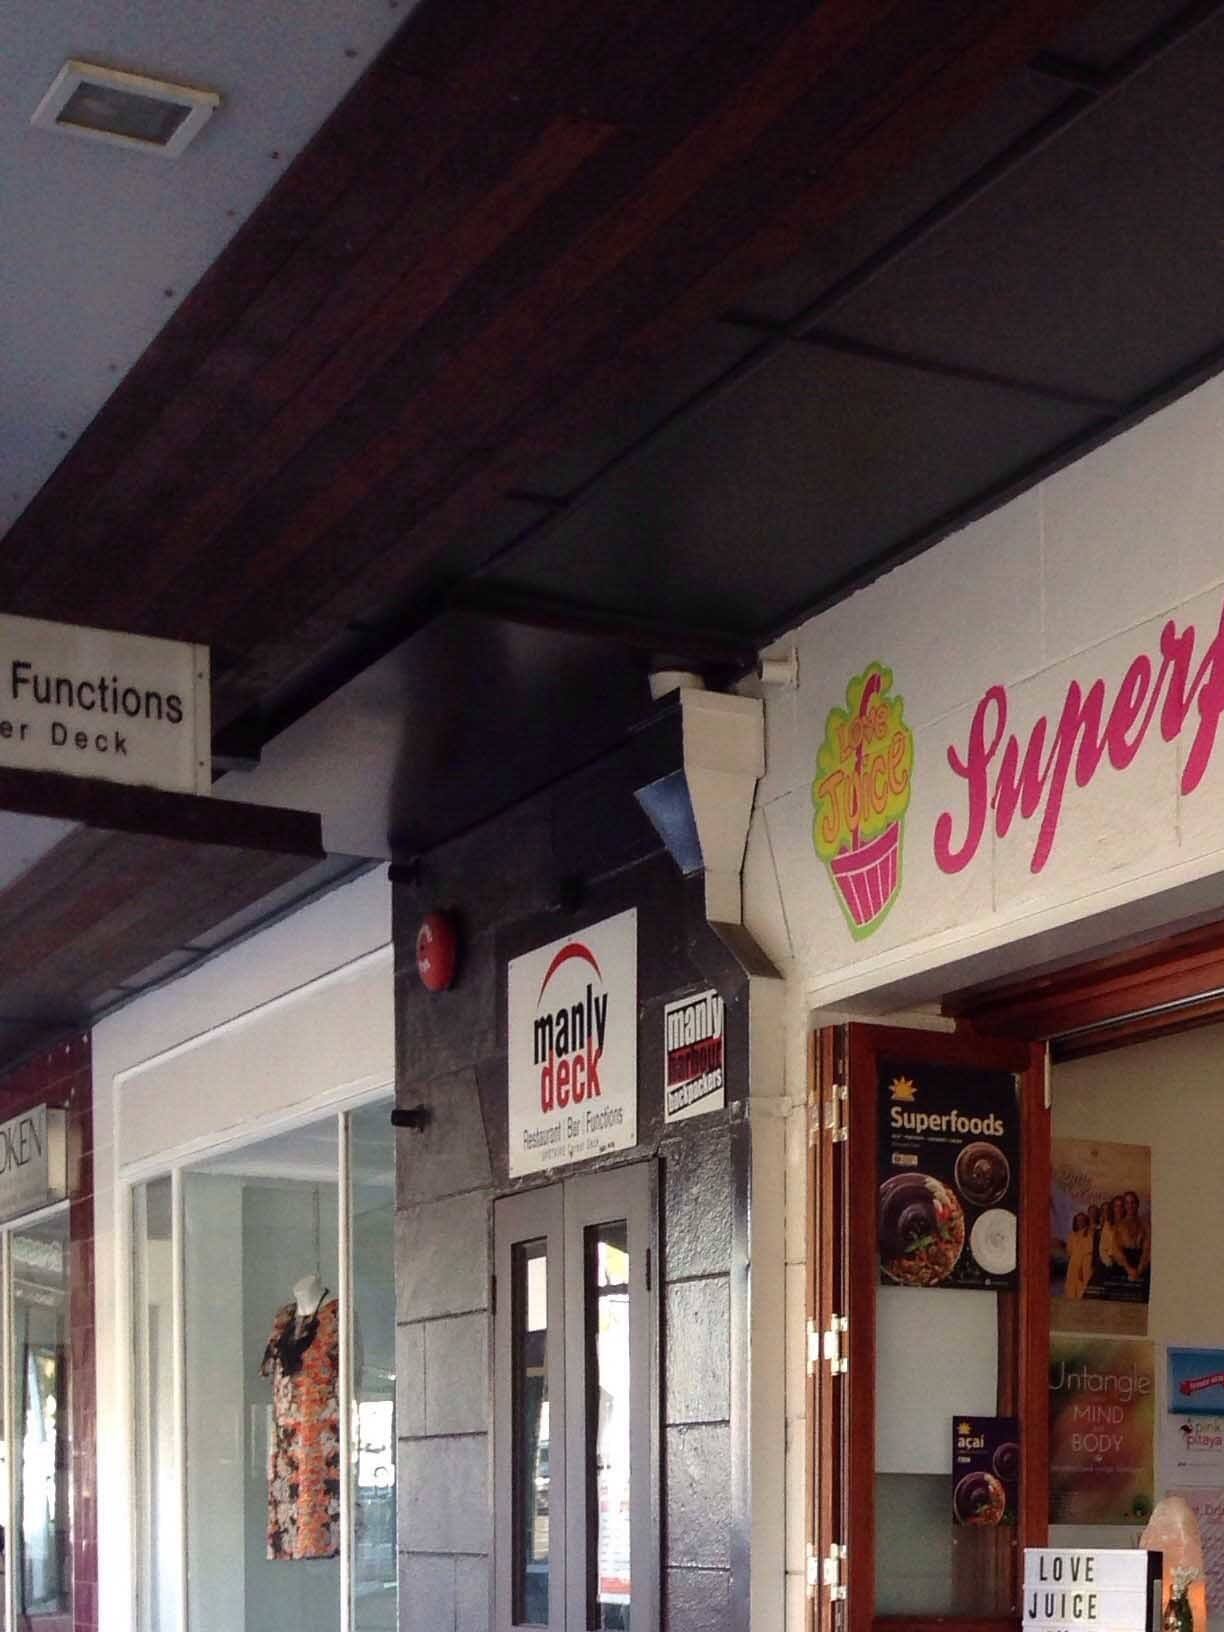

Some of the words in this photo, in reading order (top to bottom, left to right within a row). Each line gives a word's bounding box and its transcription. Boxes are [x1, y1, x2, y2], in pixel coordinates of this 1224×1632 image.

[12, 659, 184, 725] Functions
[51, 721, 128, 756] Deck
[533, 983, 608, 1065] manly
[667, 993, 724, 1052] manly
[540, 1035, 603, 1115] deck
[567, 1116, 581, 1138] Bar
[890, 1106, 1005, 1137] Superfoods
[1072, 1404, 1125, 1425] MIND
[1071, 1432, 1125, 1454] BODY
[1039, 1555, 1095, 1583] LOVE
[1028, 1591, 1097, 1620] JUICE
